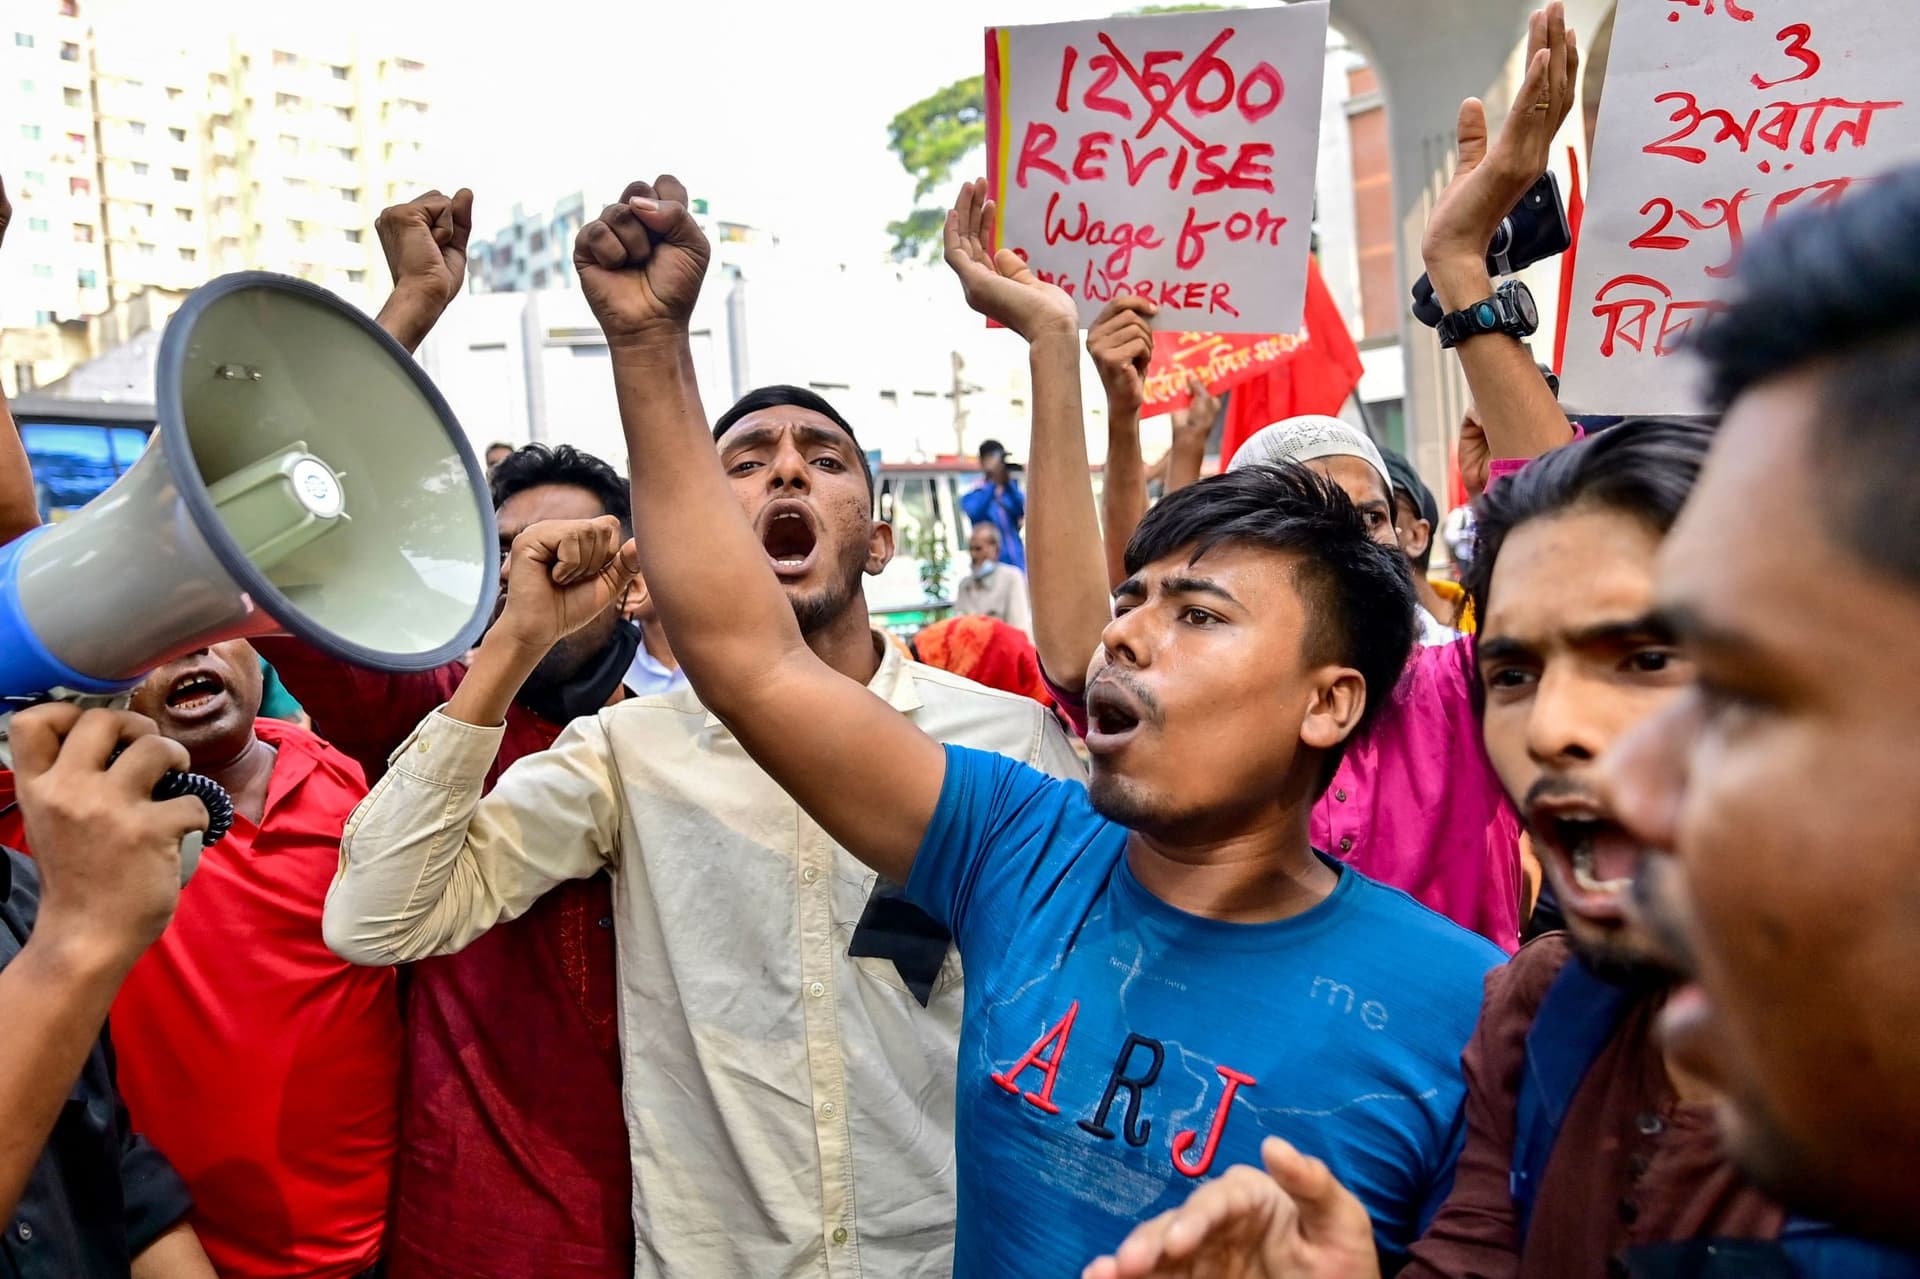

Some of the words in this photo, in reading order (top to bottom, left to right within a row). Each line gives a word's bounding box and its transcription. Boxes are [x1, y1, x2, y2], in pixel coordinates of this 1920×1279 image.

[1056, 45, 1285, 123] 12500
[1016, 121, 1275, 195] REVISE
[1044, 192, 1162, 280] Wage
[1309, 975, 1389, 1031] me
